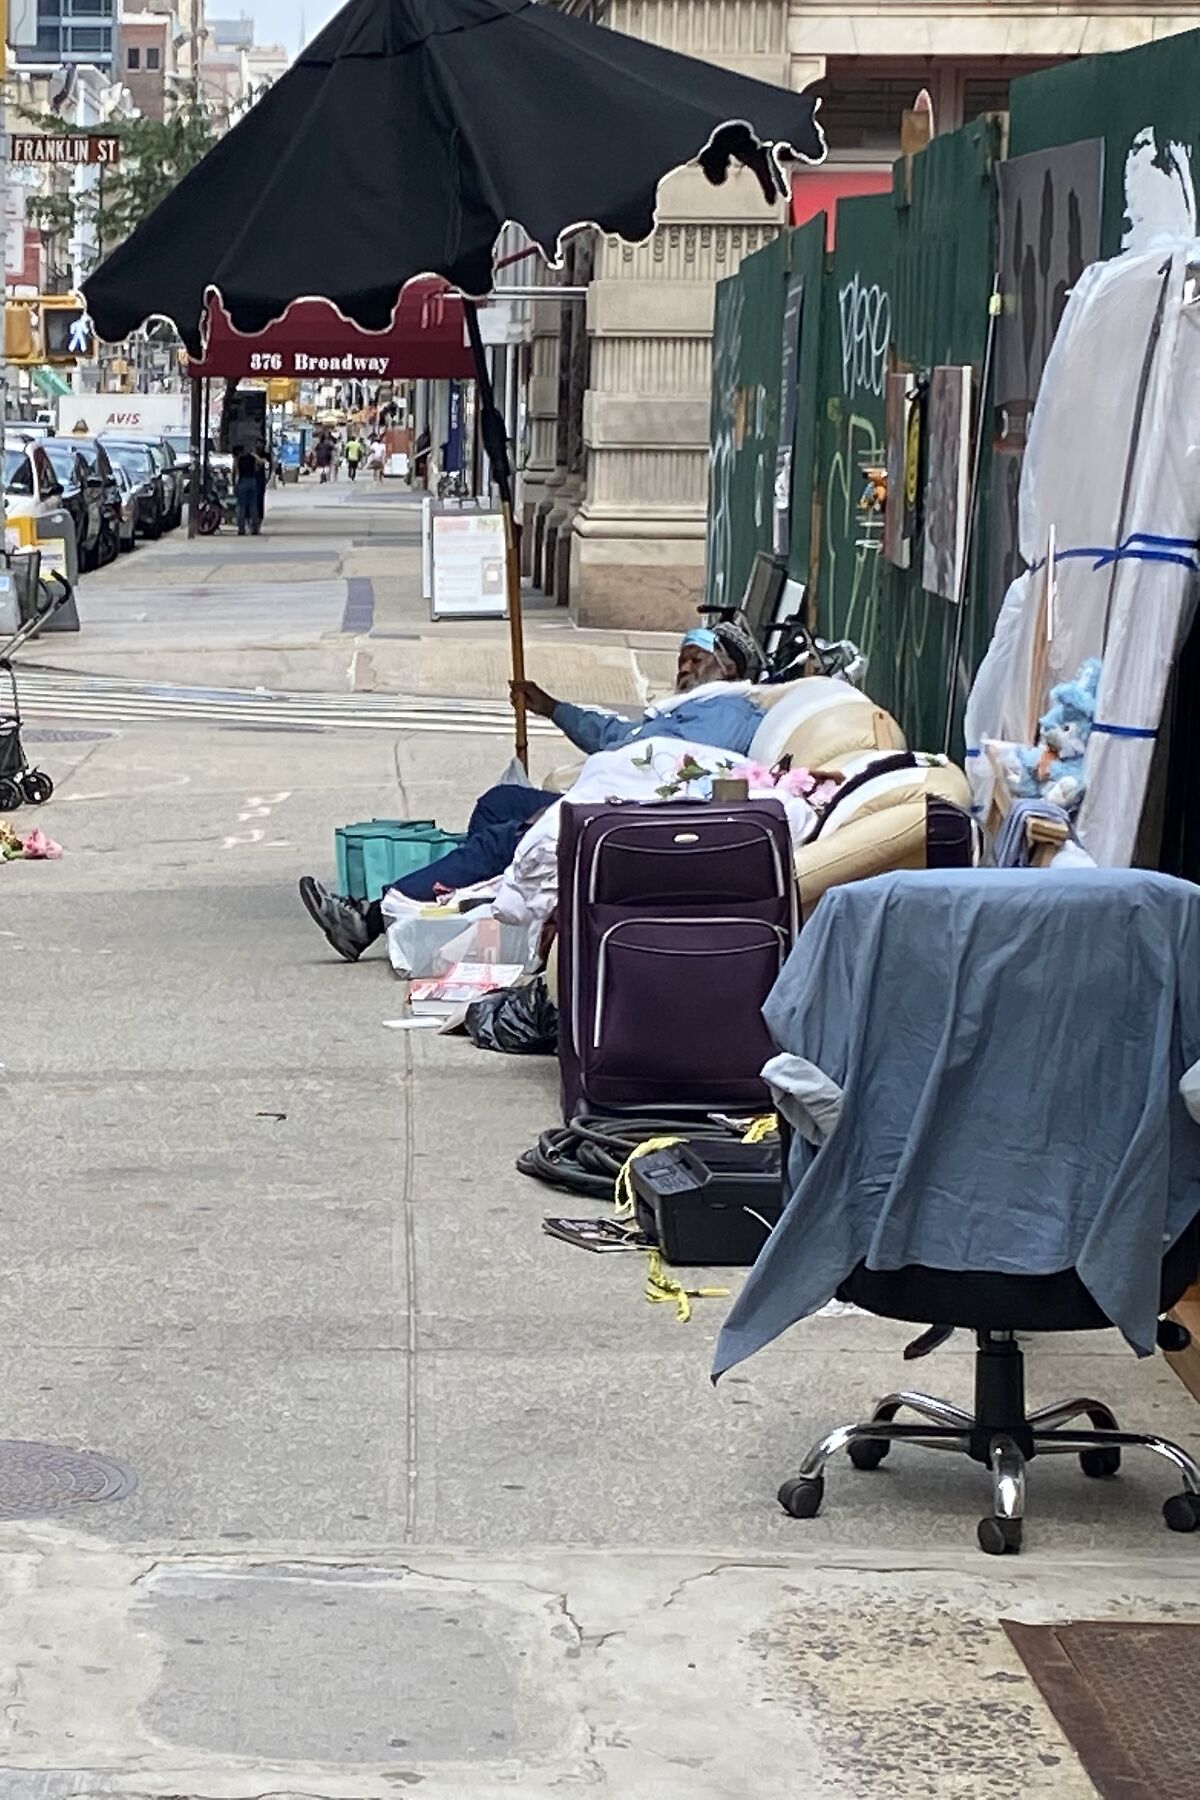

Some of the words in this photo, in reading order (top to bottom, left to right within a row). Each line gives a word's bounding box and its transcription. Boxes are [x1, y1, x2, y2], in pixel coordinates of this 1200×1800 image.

[14, 139, 89, 161] FRANKLIN
[97, 139, 117, 162] ST
[294, 352, 390, 375] Broadway
[106, 412, 142, 426] AVIS
